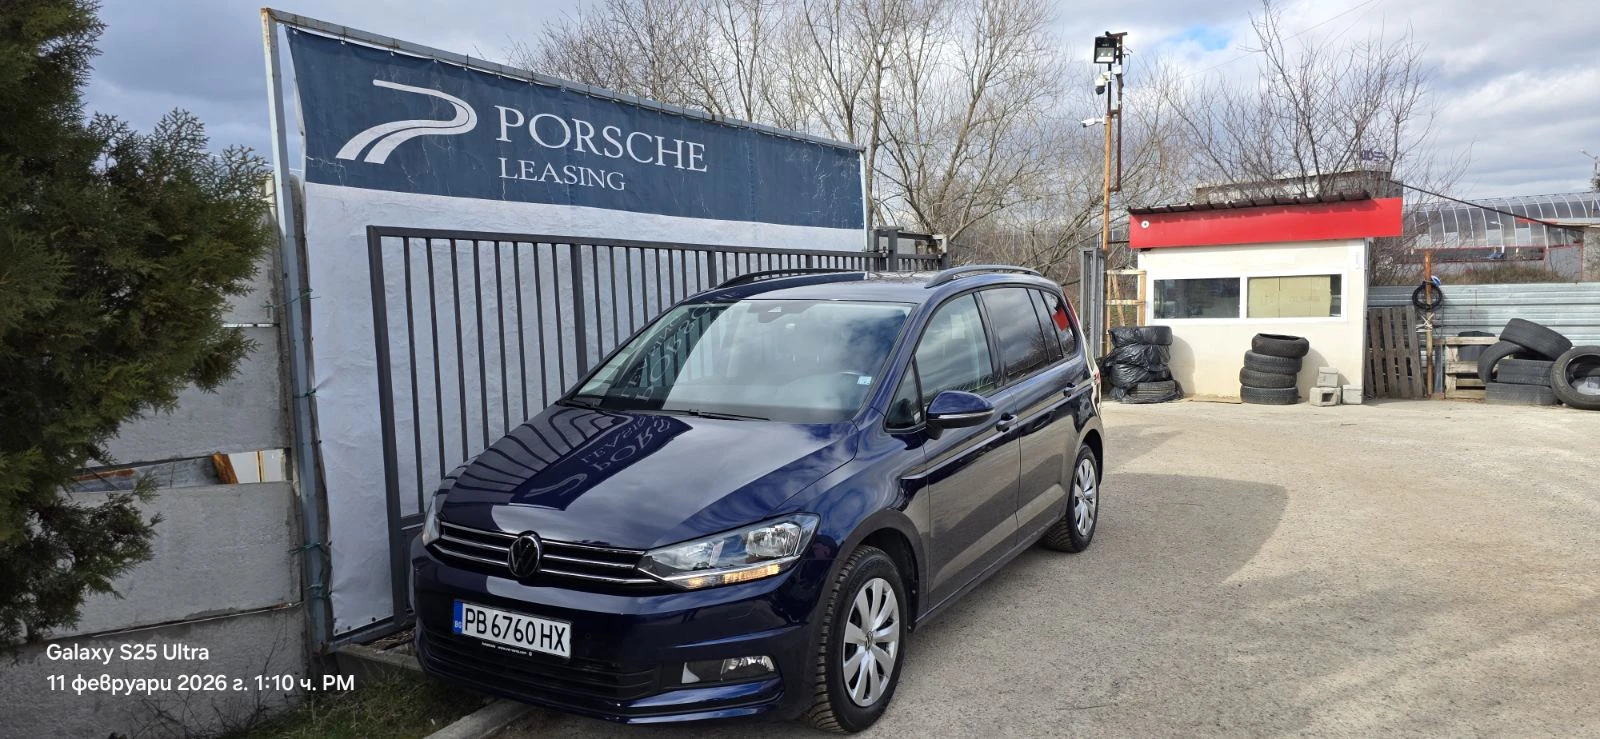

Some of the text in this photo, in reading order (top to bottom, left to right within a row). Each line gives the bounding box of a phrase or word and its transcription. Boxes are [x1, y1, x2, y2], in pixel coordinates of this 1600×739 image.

[494, 105, 708, 173] PORSCHE
[498, 157, 626, 192] LEASING
[465, 607, 487, 635] PB
[491, 613, 536, 646] 6760
[540, 623, 566, 652] HX
